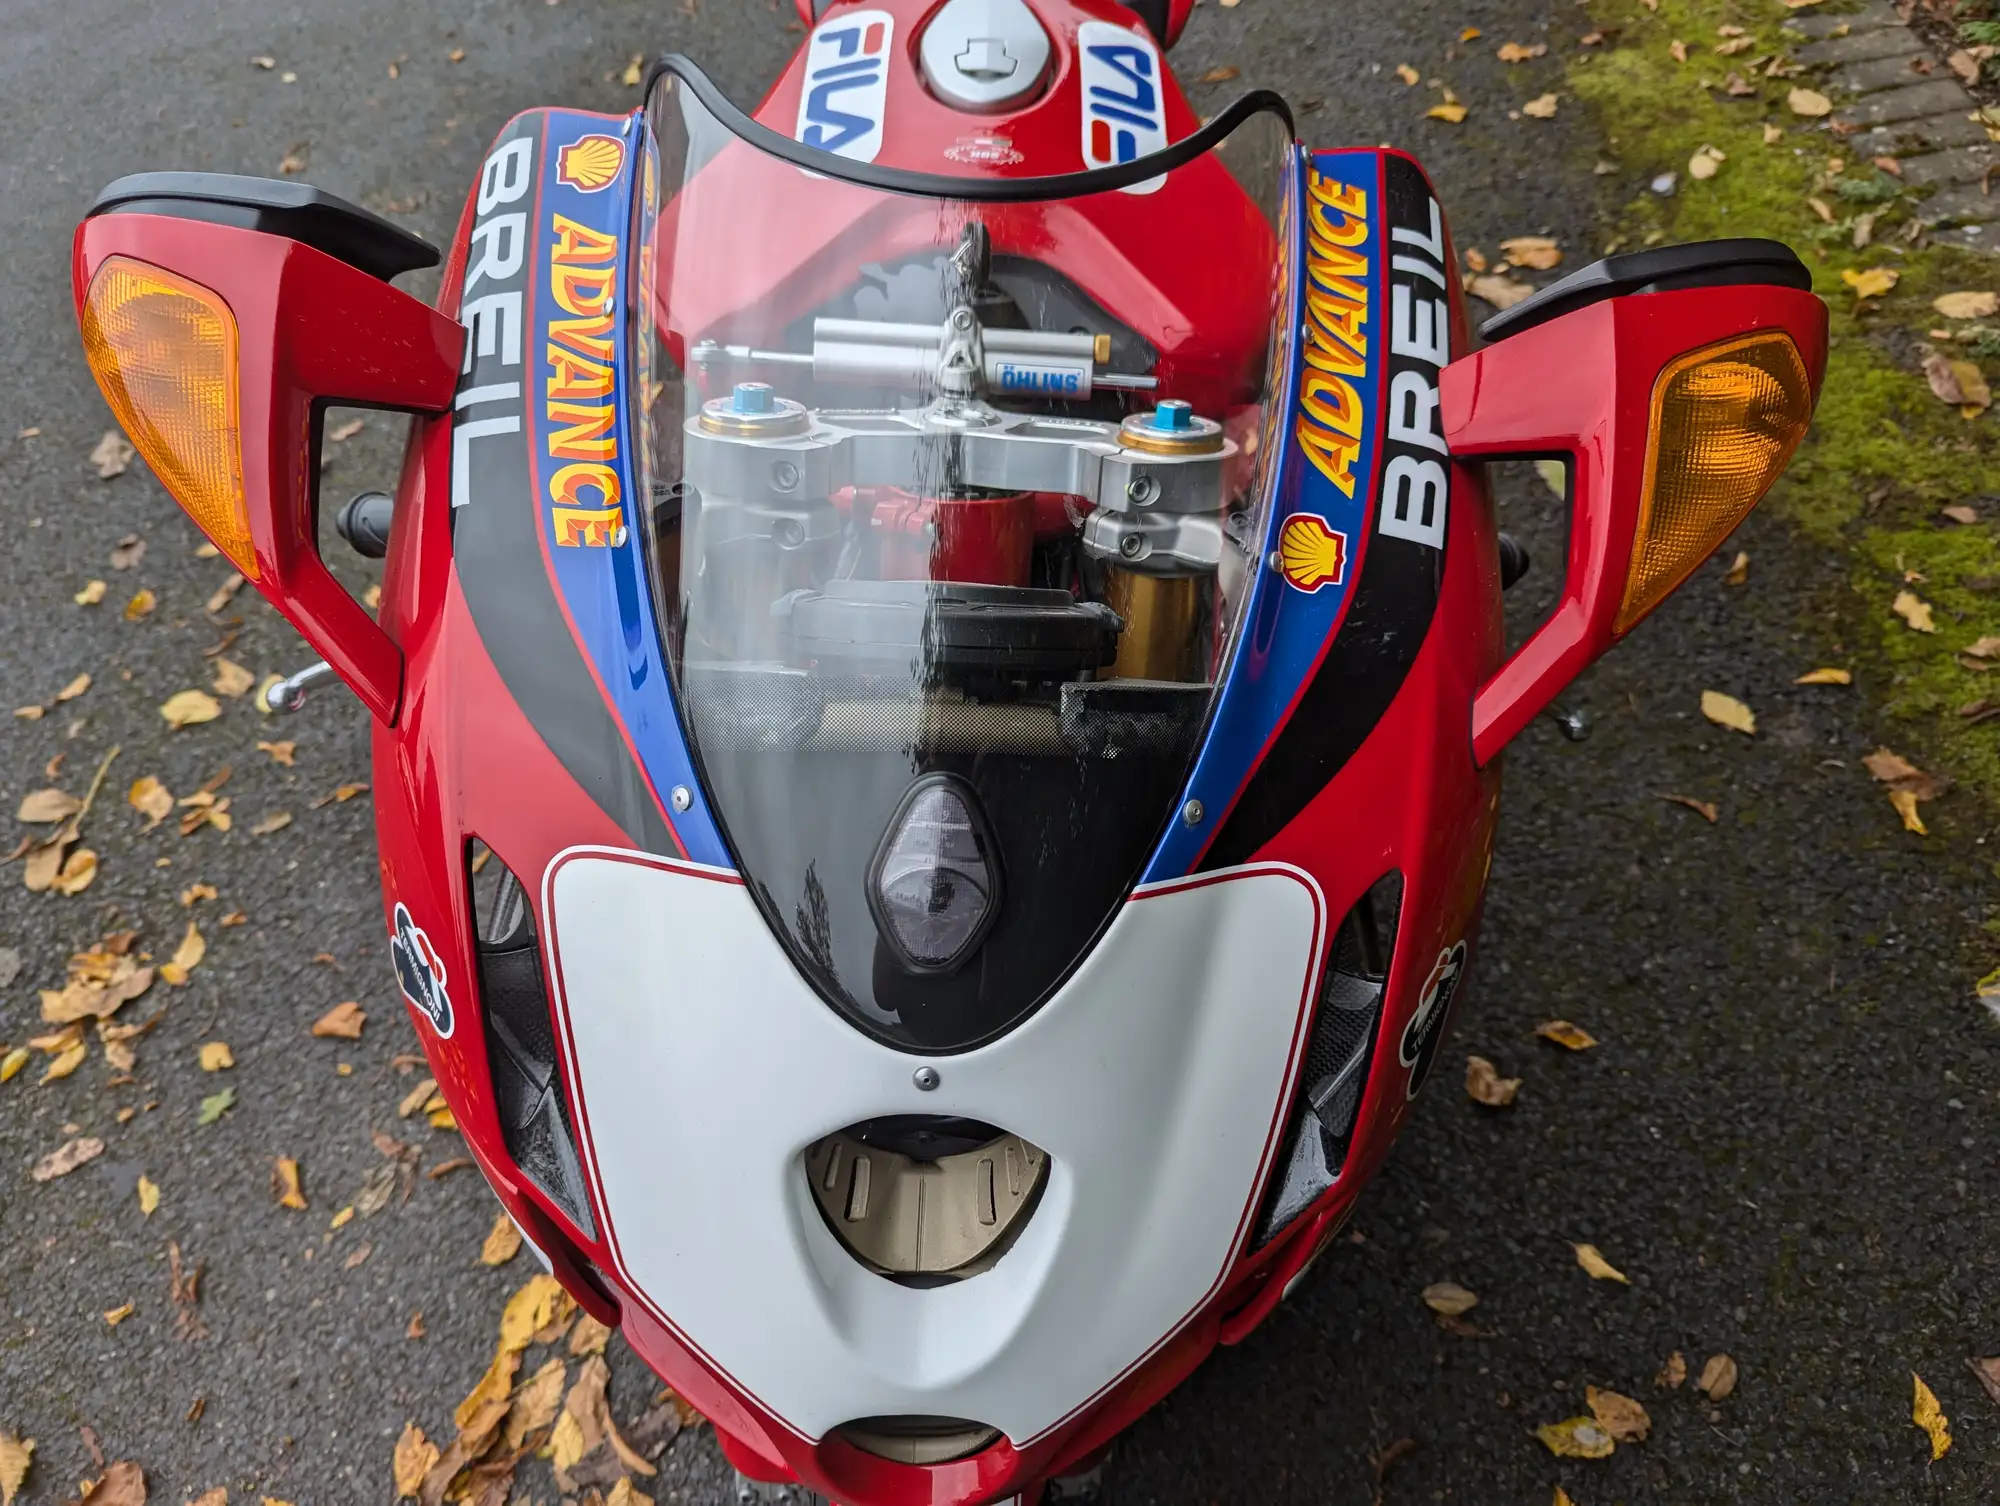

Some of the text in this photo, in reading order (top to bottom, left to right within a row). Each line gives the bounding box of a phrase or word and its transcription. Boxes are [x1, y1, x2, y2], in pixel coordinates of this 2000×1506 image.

[452, 136, 533, 508] BREIL
[546, 213, 624, 548] ADVANCE
[1002, 365, 1079, 393] ÖHLINS
[1297, 166, 1369, 499] ADVANCE
[1379, 197, 1449, 550] BREIL
[400, 927, 441, 1022] TERMIGNONI
